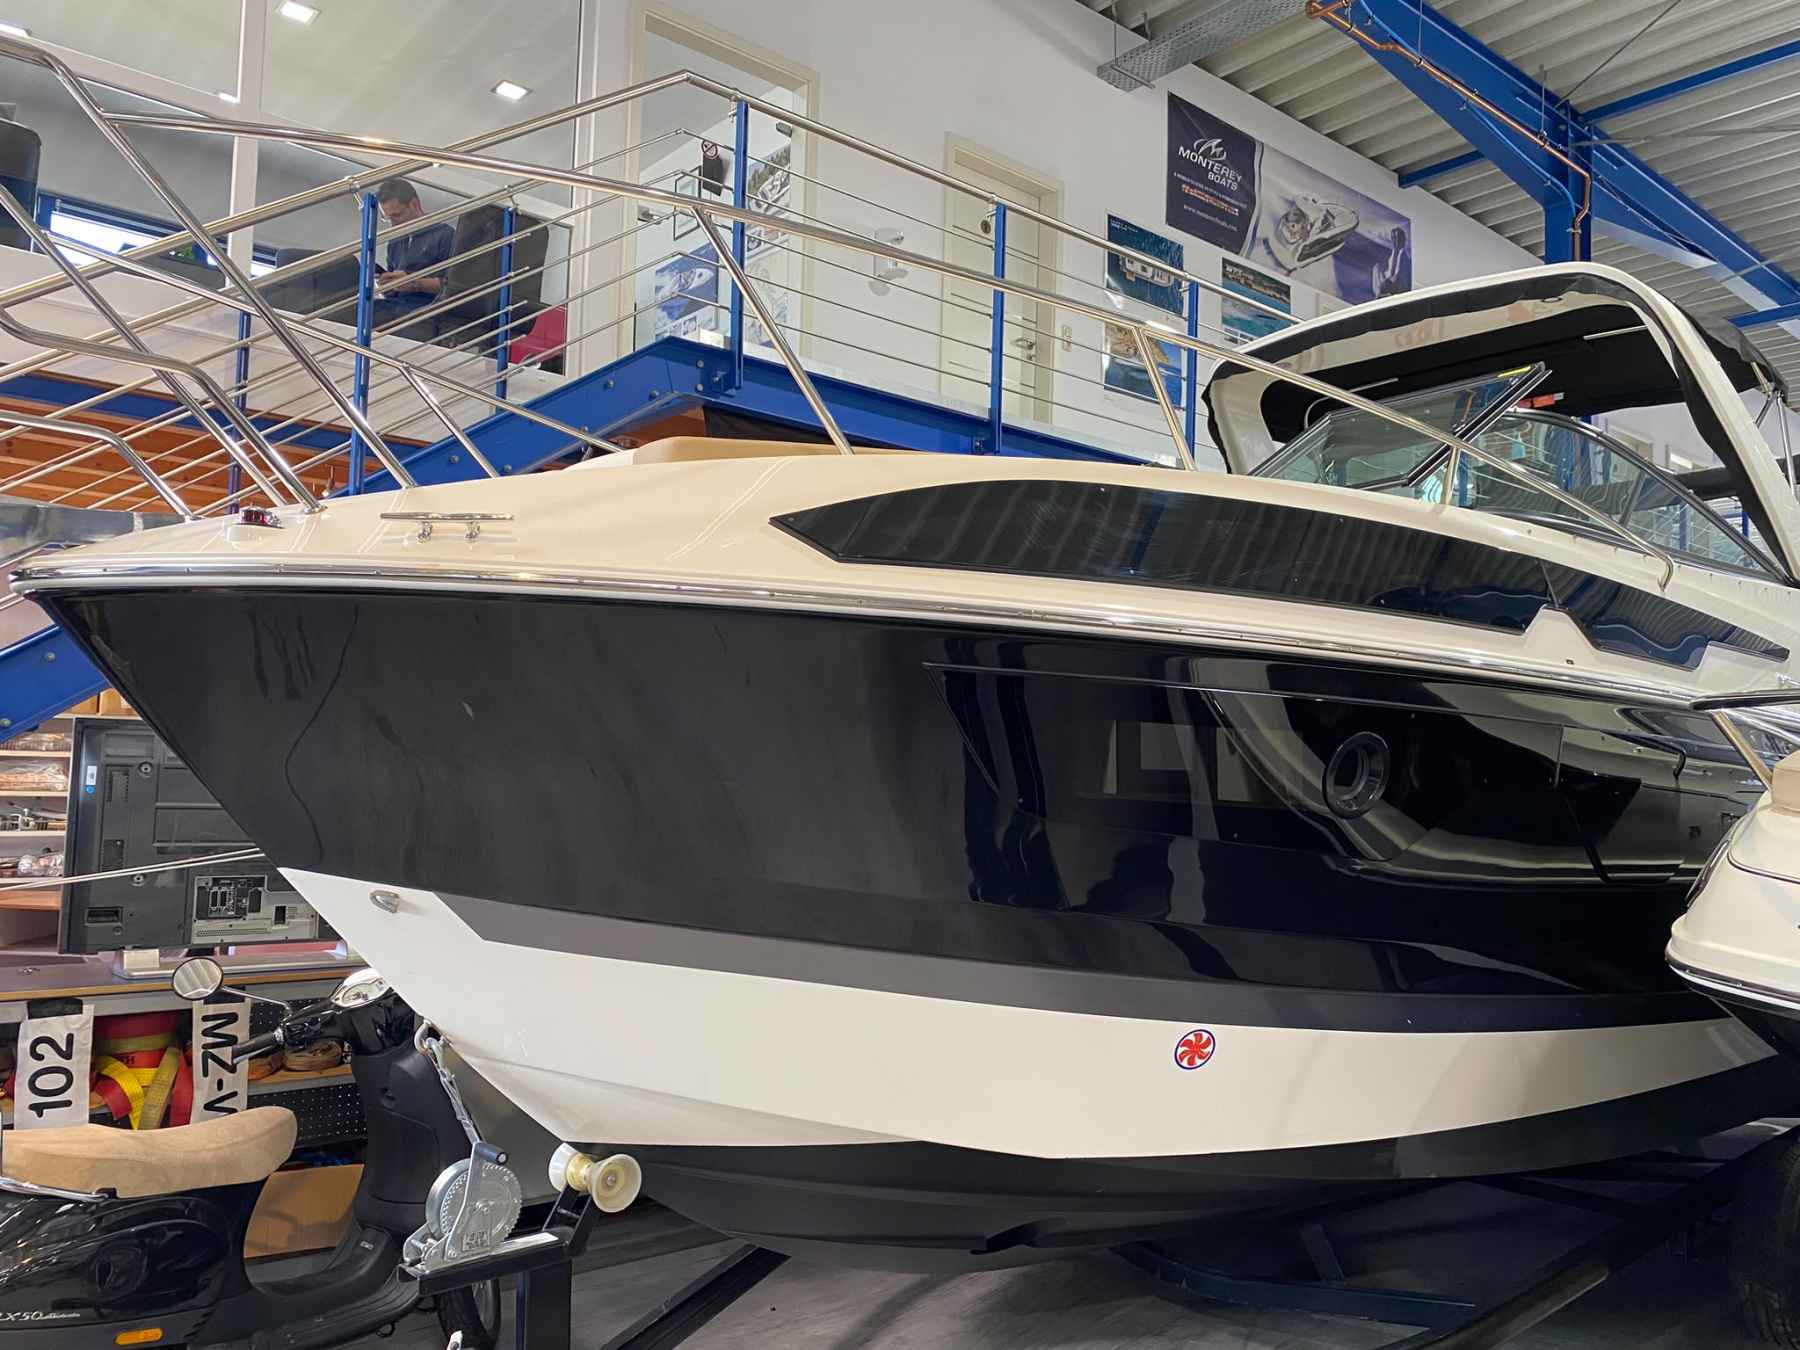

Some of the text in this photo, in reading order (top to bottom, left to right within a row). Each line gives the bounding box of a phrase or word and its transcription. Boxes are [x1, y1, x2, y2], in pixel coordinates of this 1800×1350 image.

[1178, 146, 1242, 183] MONTEREY
[1208, 171, 1238, 191] BOATS
[28, 1032, 74, 1118] 102
